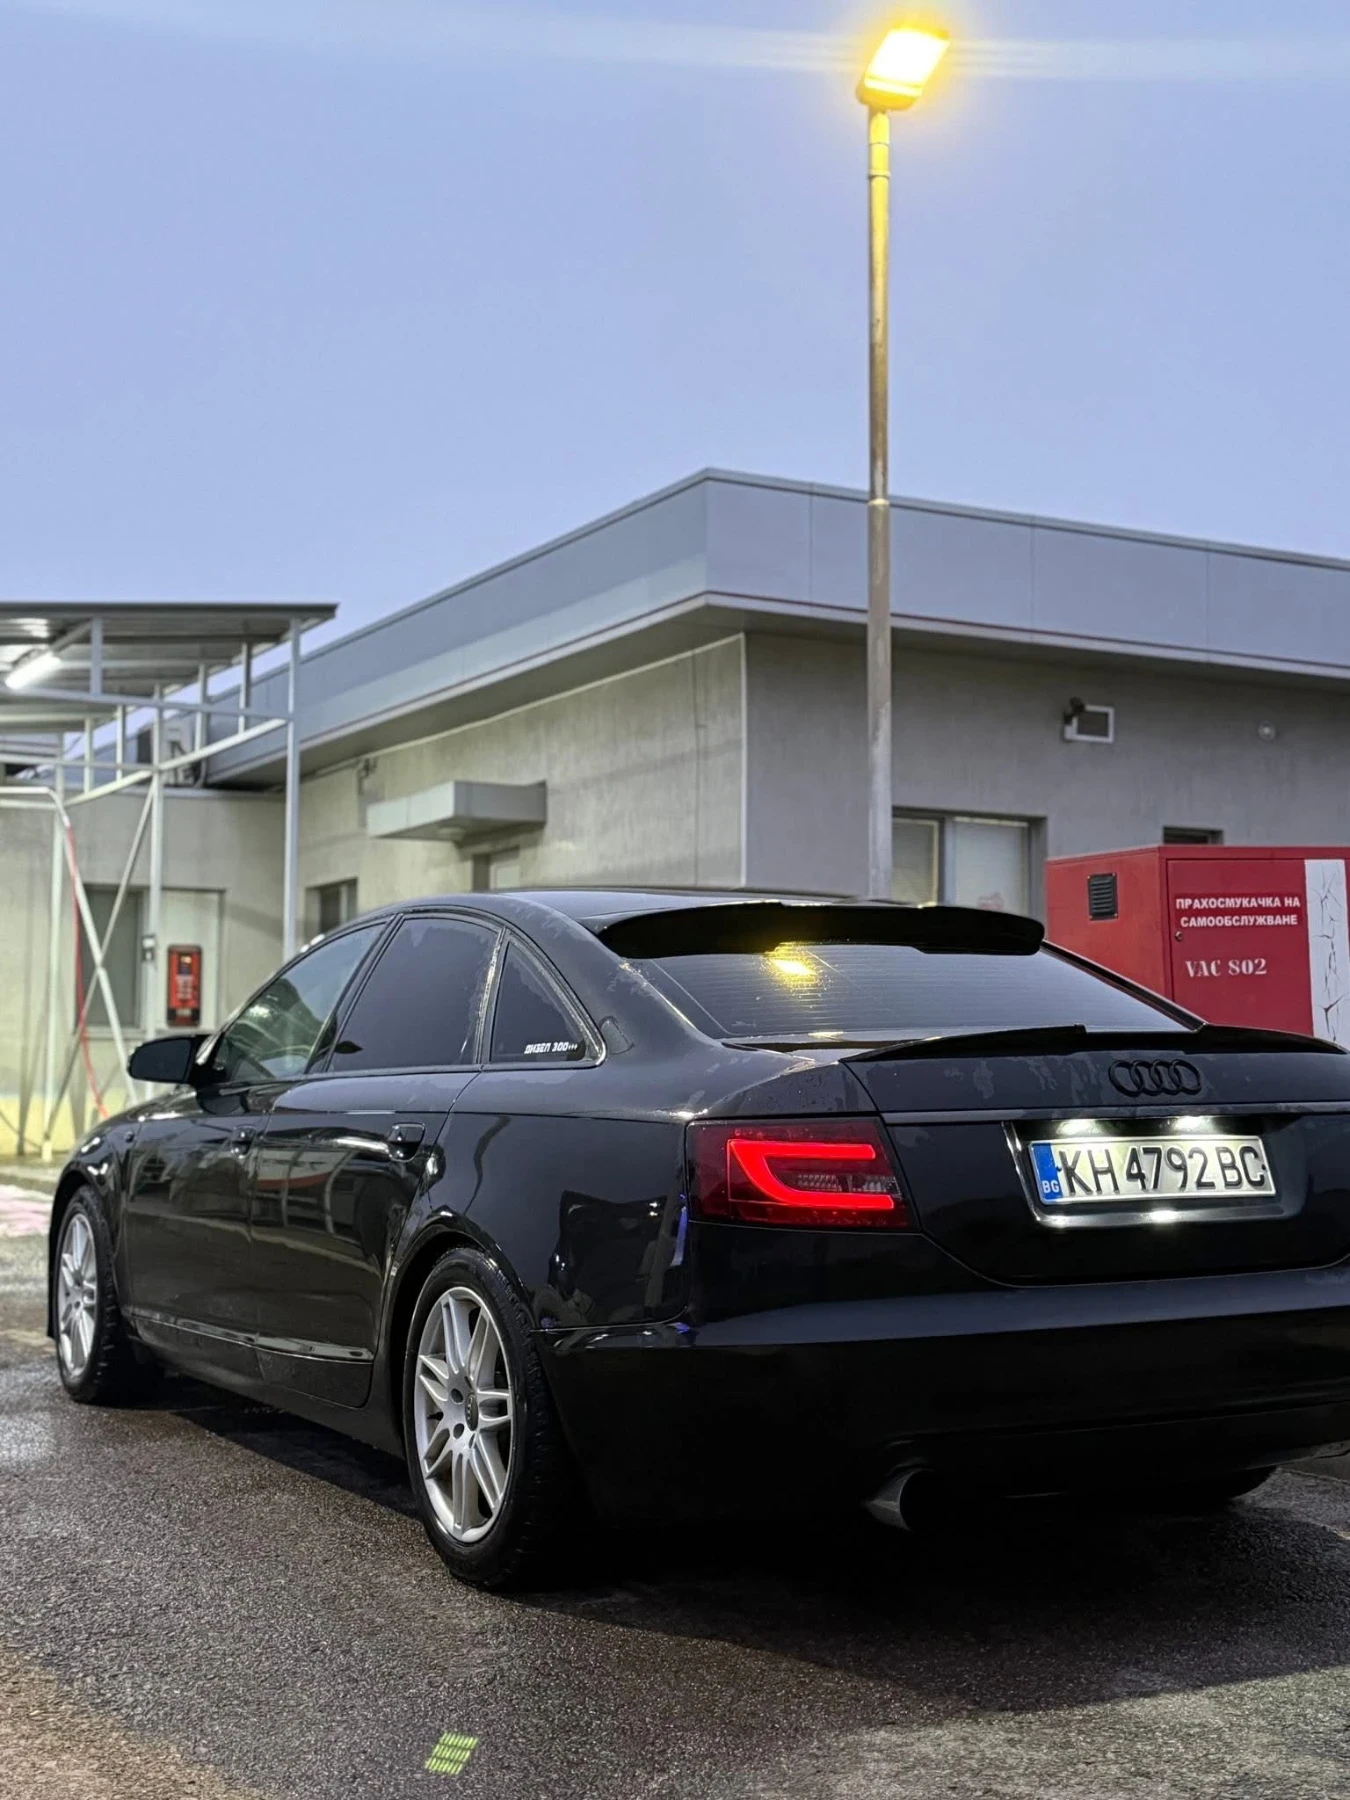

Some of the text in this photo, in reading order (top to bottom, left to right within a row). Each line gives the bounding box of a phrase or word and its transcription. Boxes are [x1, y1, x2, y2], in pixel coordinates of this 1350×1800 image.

[1175, 897, 1300, 909] ПРАХОСМУКАЧКА НА
[1181, 914, 1298, 927] САМООБСЛУЖВАНЕ
[1185, 958, 1267, 977] VAC 802
[1042, 1180, 1059, 1193] BG
